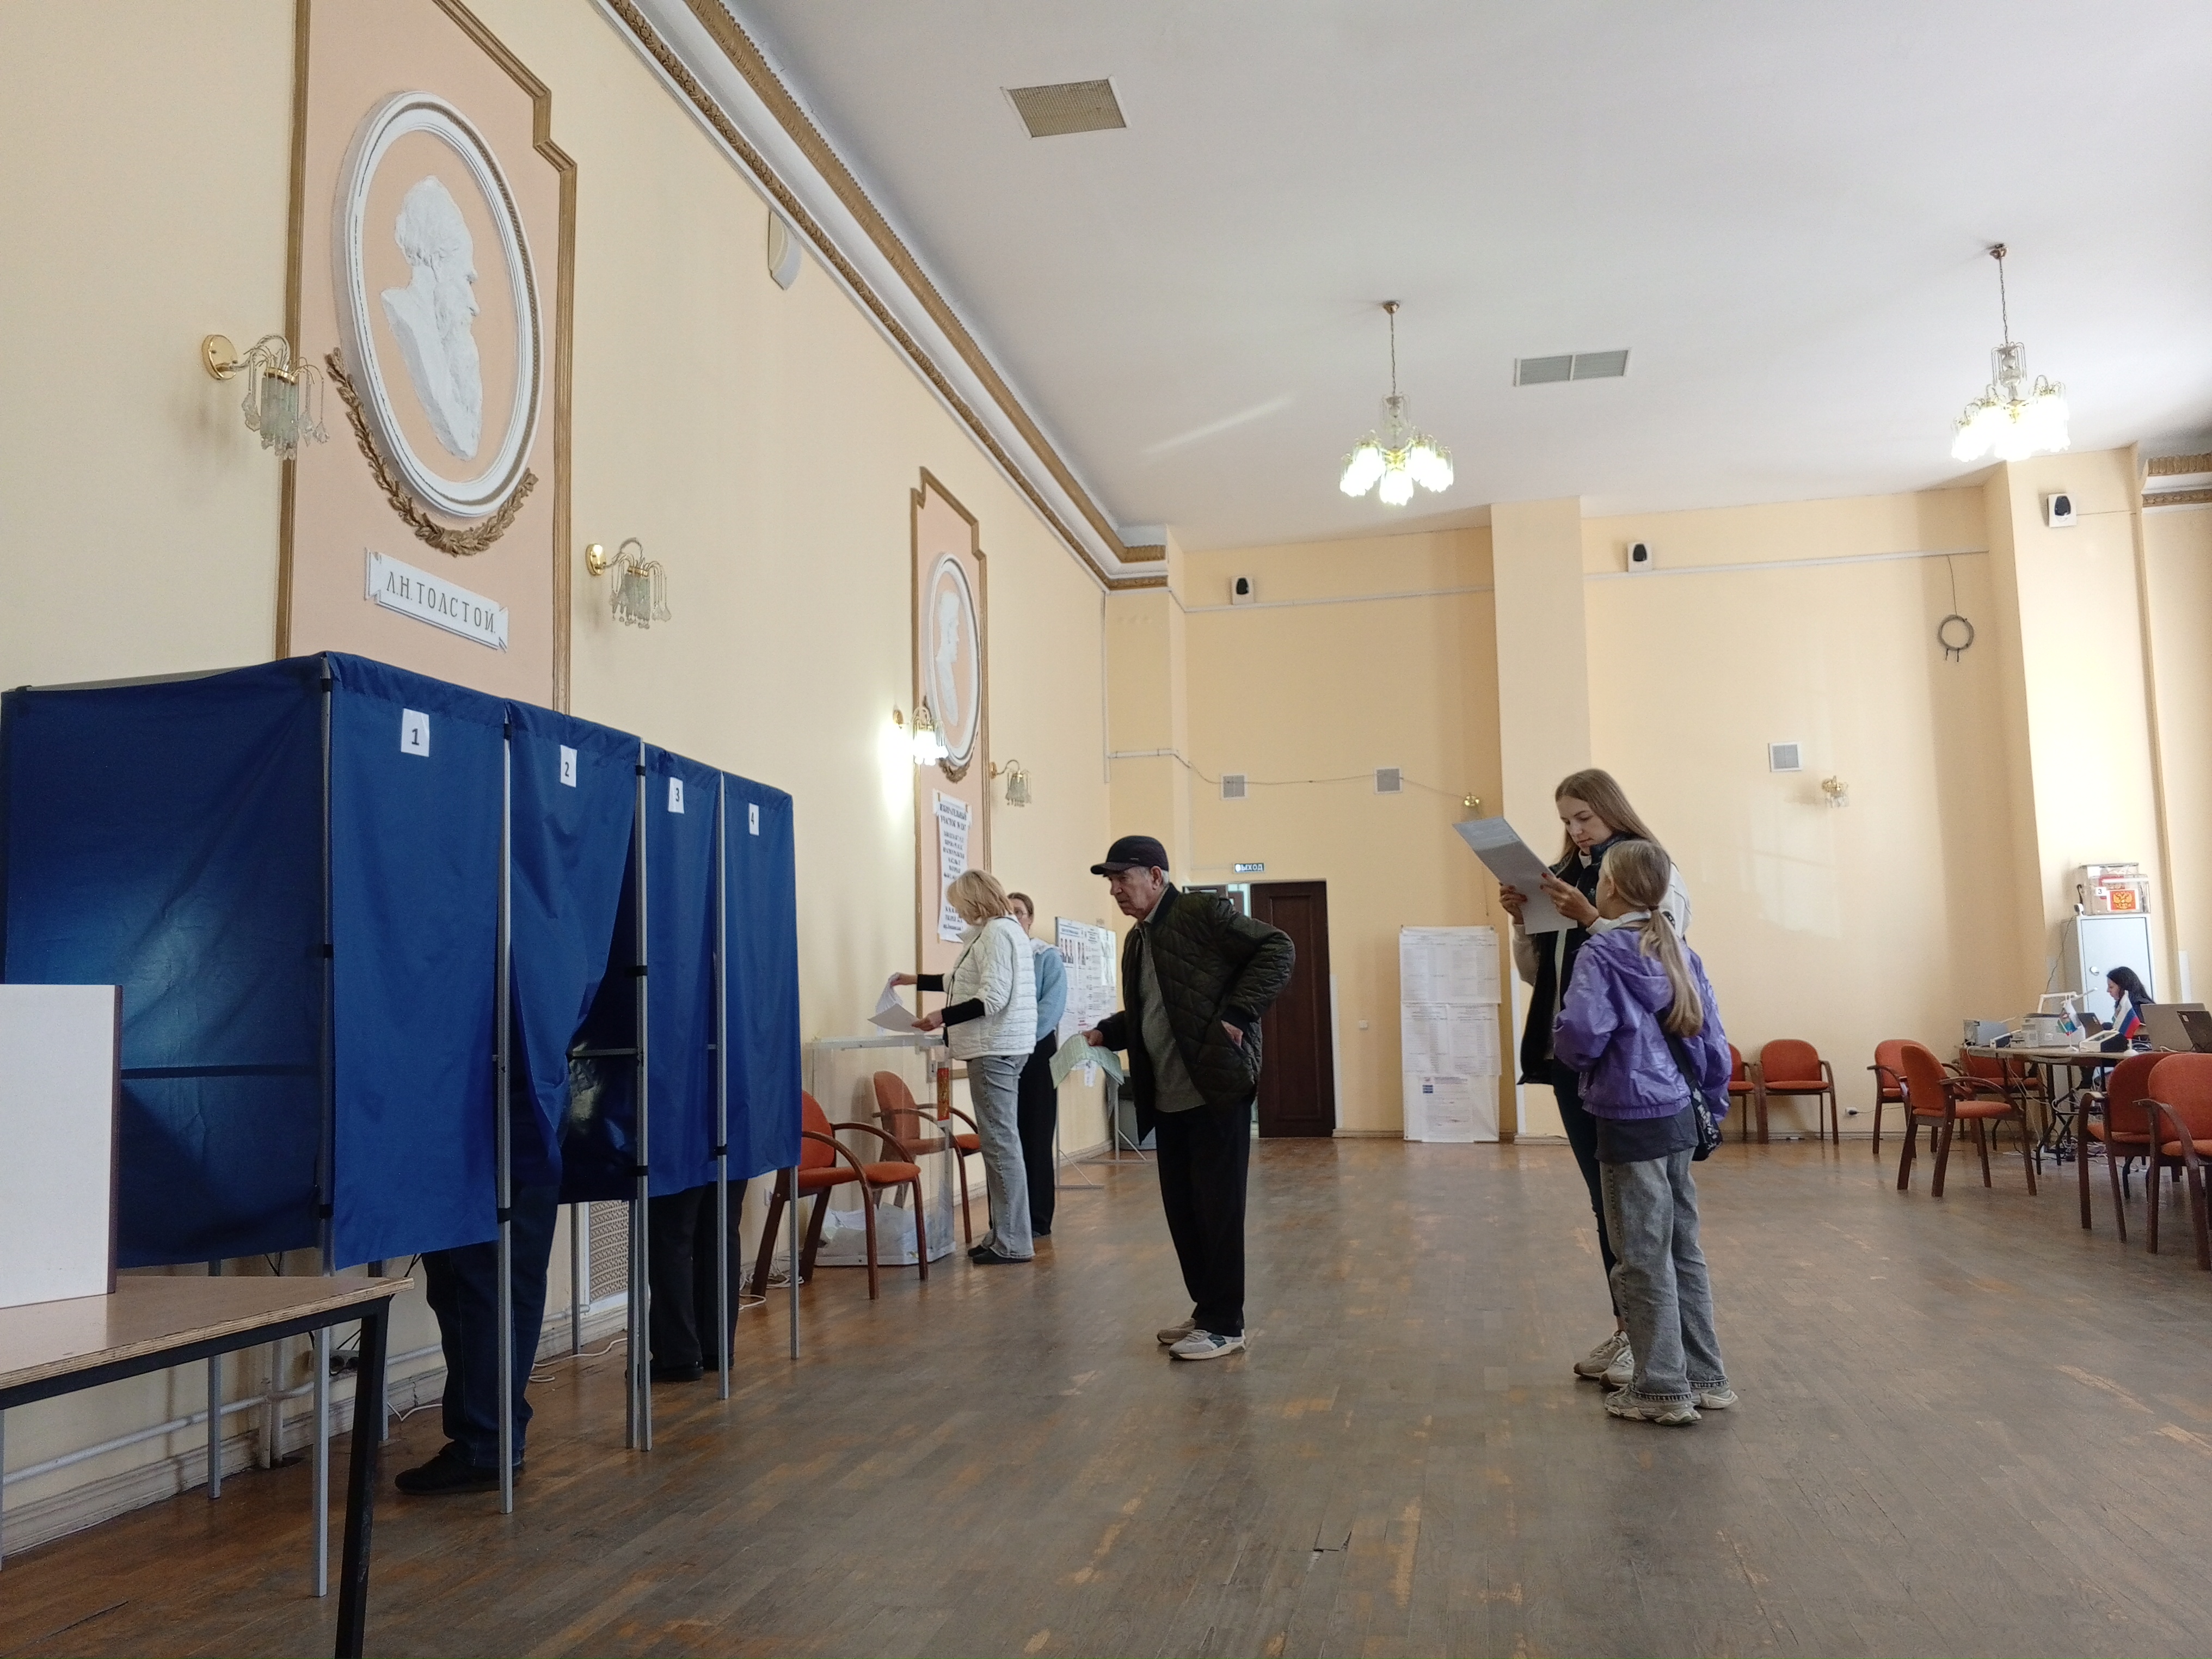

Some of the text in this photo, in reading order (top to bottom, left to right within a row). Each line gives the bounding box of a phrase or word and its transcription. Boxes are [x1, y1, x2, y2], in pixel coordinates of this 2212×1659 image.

[411, 728, 420, 746] 1
[564, 762, 569, 777] 2
[675, 788, 680, 802] 3
[751, 812, 755, 826] 4
